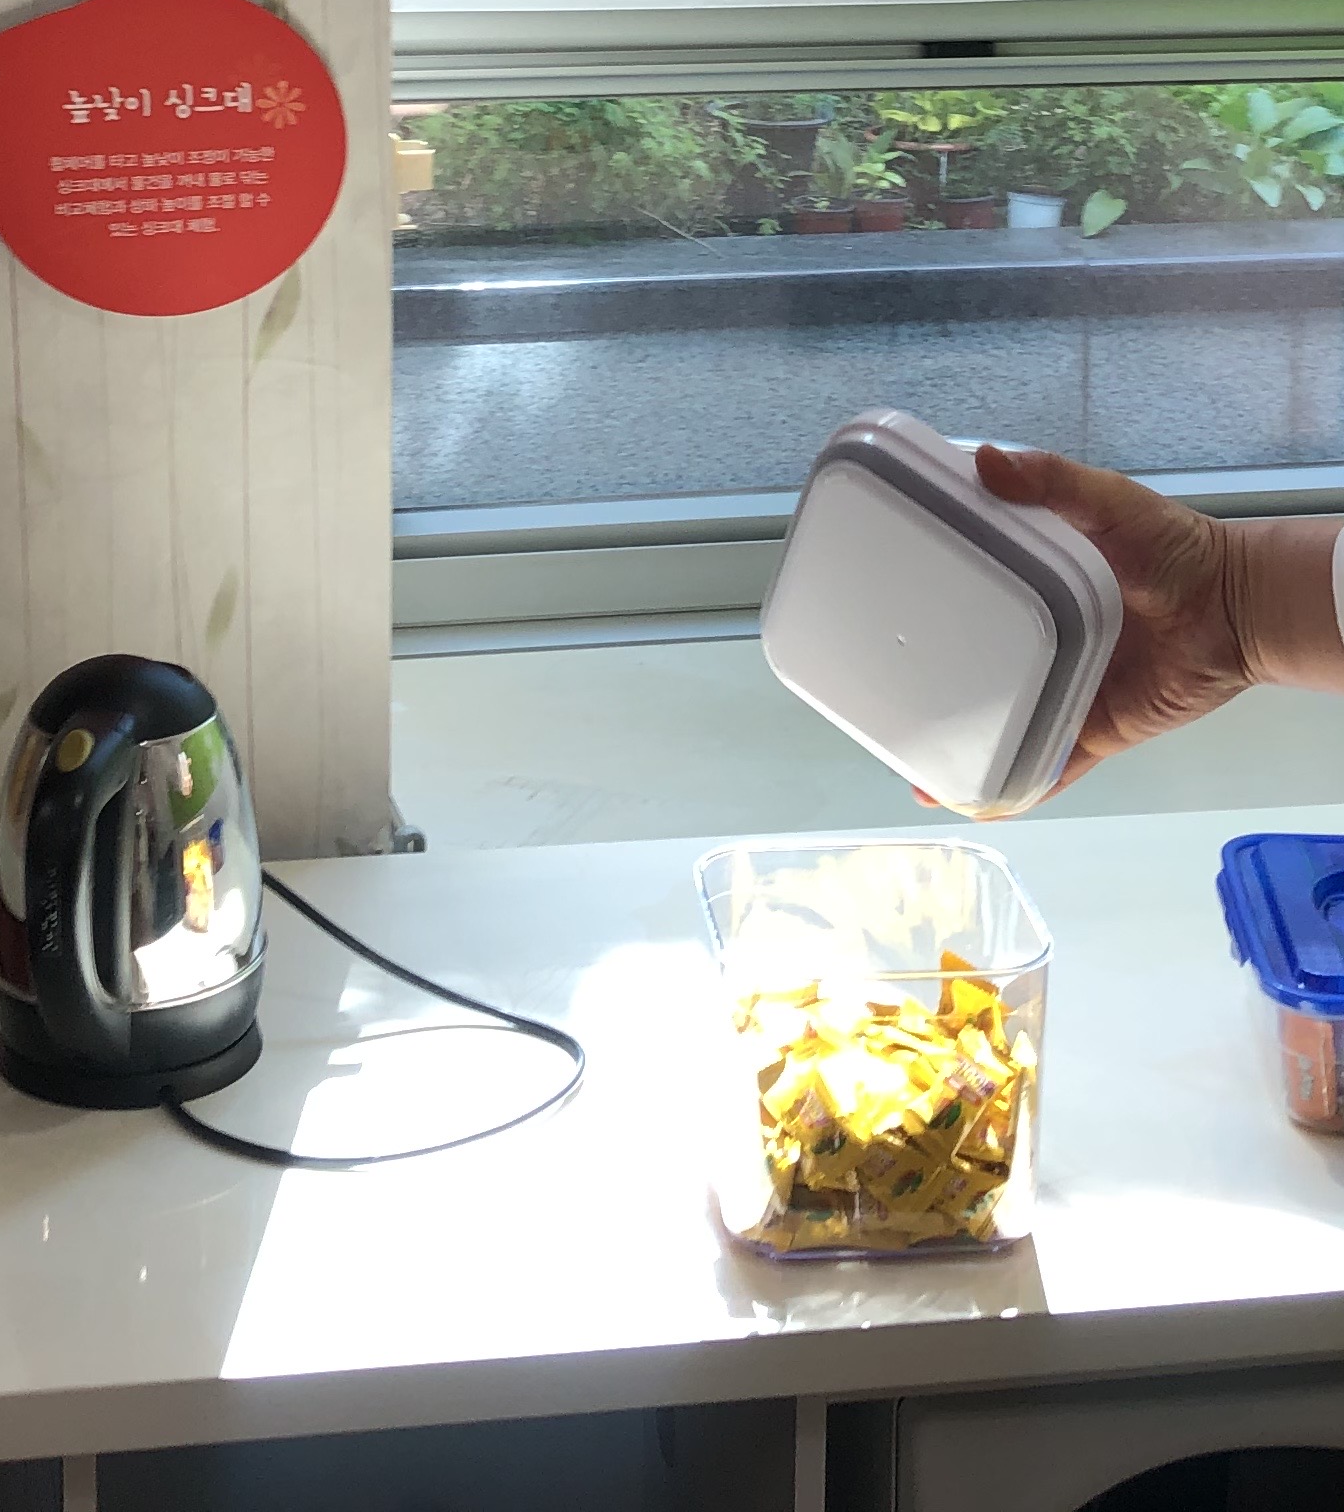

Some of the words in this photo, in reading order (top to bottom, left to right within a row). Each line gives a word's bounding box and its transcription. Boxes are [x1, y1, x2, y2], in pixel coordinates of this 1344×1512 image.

[62, 87, 151, 123] 높낮이
[164, 82, 252, 118] 싱크대
[141, 151, 185, 168] 높낮이
[231, 146, 276, 163] 가능한
[255, 192, 271, 207] 수
[140, 219, 184, 236] 싱크대
